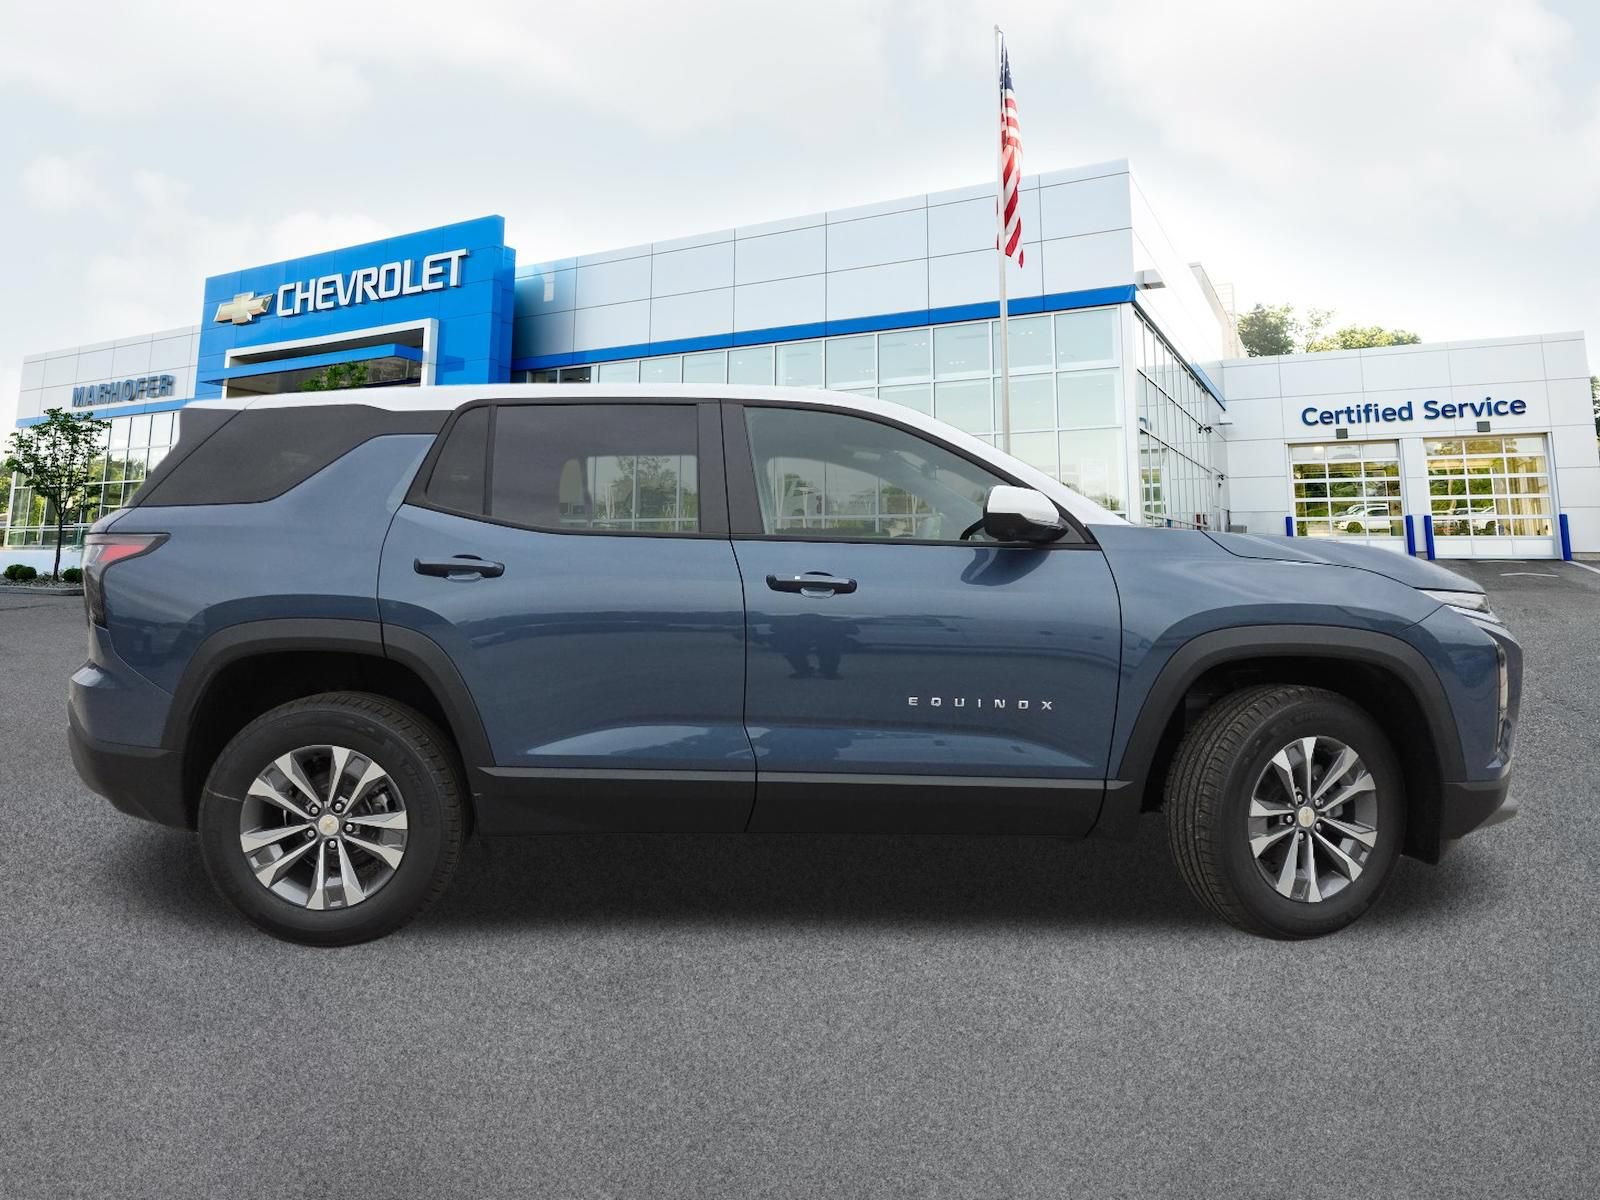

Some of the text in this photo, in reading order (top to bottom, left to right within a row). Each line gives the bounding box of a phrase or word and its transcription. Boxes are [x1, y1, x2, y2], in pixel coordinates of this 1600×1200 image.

[276, 248, 469, 317] CHEVROLET
[72, 375, 176, 407] MARHOFER
[1301, 396, 1527, 426] Certified Service
[908, 696, 1052, 710] EQUINOX
